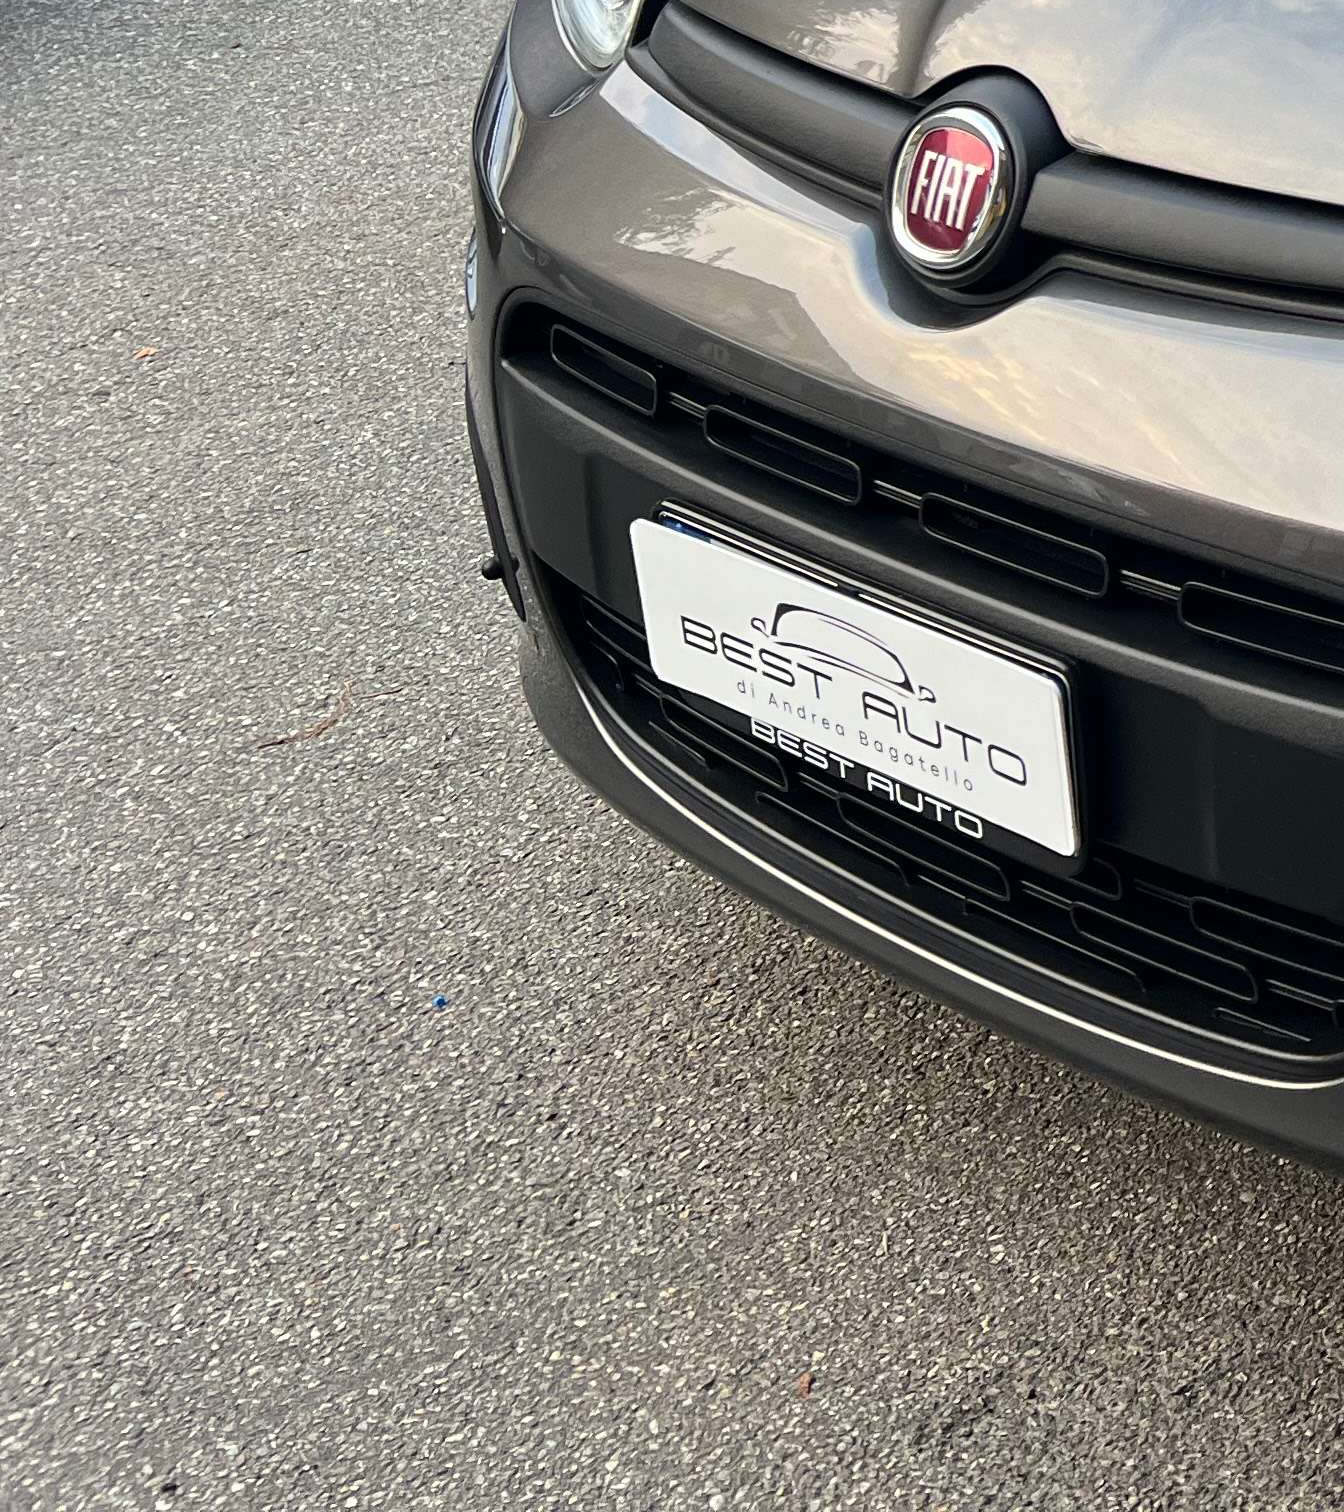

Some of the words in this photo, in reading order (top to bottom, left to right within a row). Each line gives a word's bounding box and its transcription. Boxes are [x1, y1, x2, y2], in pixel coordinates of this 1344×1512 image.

[910, 149, 985, 232] FIAT
[680, 615, 833, 700] BEST
[862, 691, 1027, 786] AUTO
[737, 680, 756, 698] di
[768, 692, 845, 737] Andrea
[859, 729, 973, 791] Bagatello
[750, 717, 855, 779] BEST
[867, 771, 983, 839] AUTO
